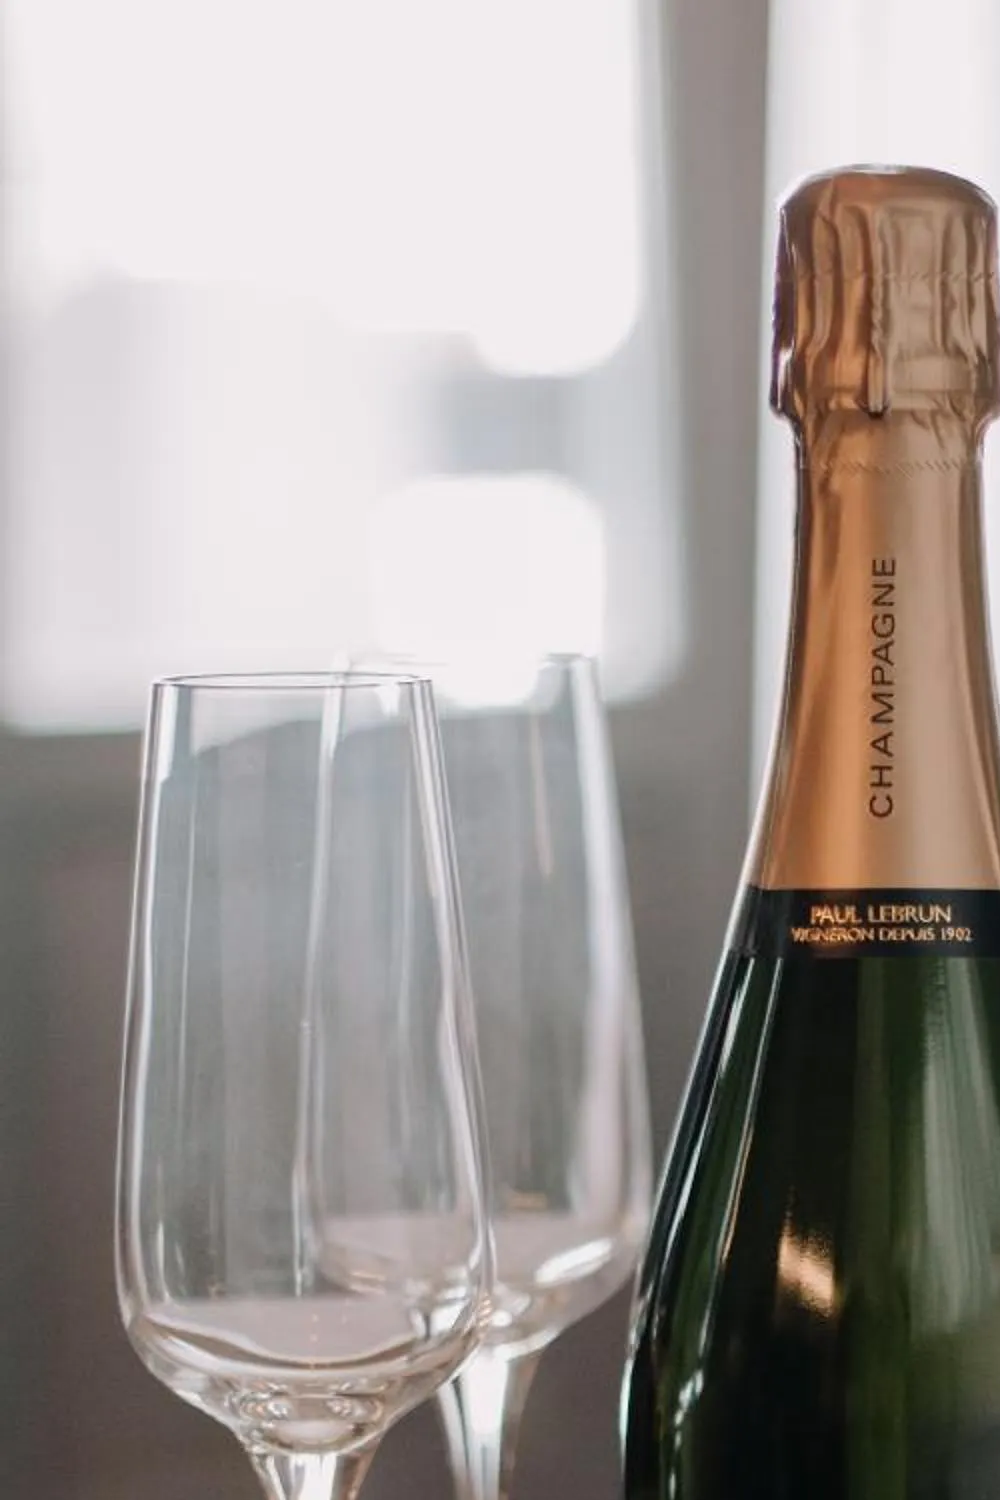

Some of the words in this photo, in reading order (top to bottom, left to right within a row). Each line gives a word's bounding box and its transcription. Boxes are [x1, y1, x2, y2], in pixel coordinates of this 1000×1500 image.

[868, 557, 896, 818] CHAMPAGNE
[810, 904, 862, 925] PAUL
[867, 904, 952, 924] LEBRUN
[791, 927, 875, 943] VIGNERON
[879, 927, 936, 942] DEPUIS
[941, 927, 973, 942] 1902
